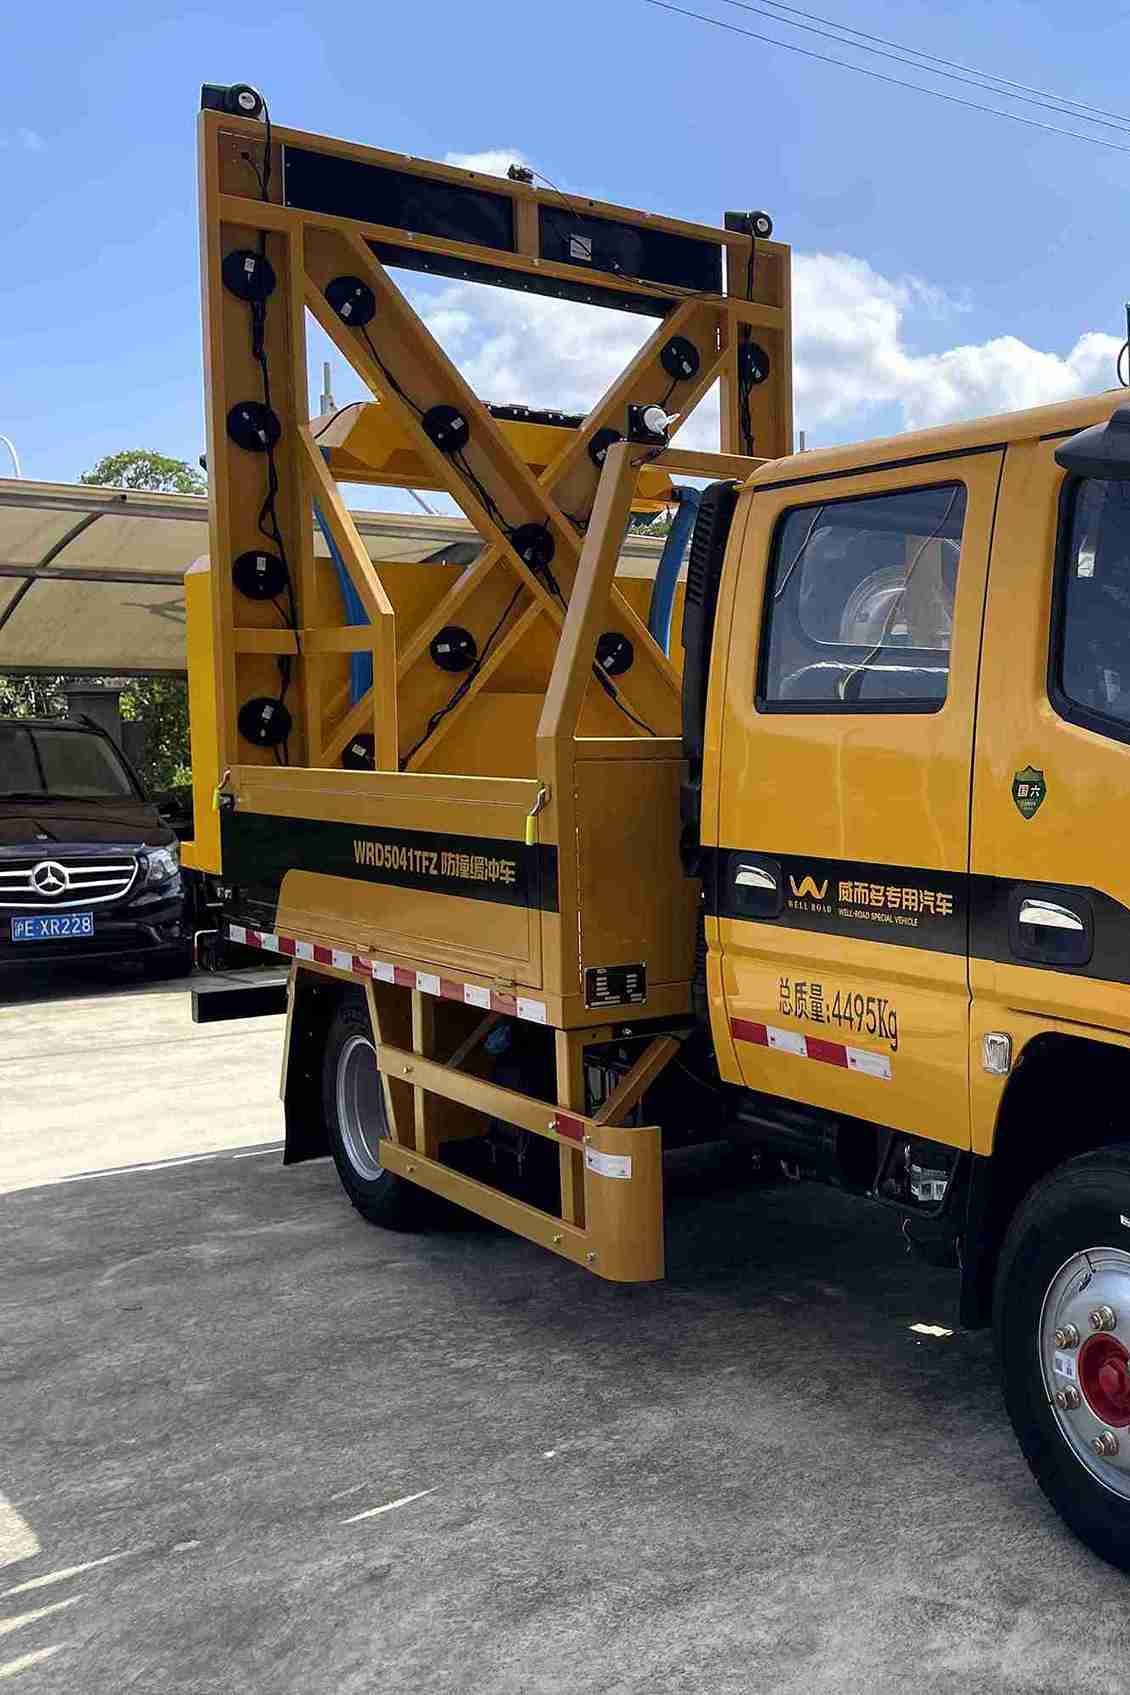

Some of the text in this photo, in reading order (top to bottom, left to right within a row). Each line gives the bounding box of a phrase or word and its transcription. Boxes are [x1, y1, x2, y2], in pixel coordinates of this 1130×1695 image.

[1017, 784, 1041, 797] 国六
[353, 840, 439, 876] WRD5041TFZ
[838, 880, 953, 916] 威而多专用汽车
[788, 900, 832, 914] WELL ROAD
[871, 912, 893, 924] SPECIAL
[895, 915, 919, 927] VEHICLE
